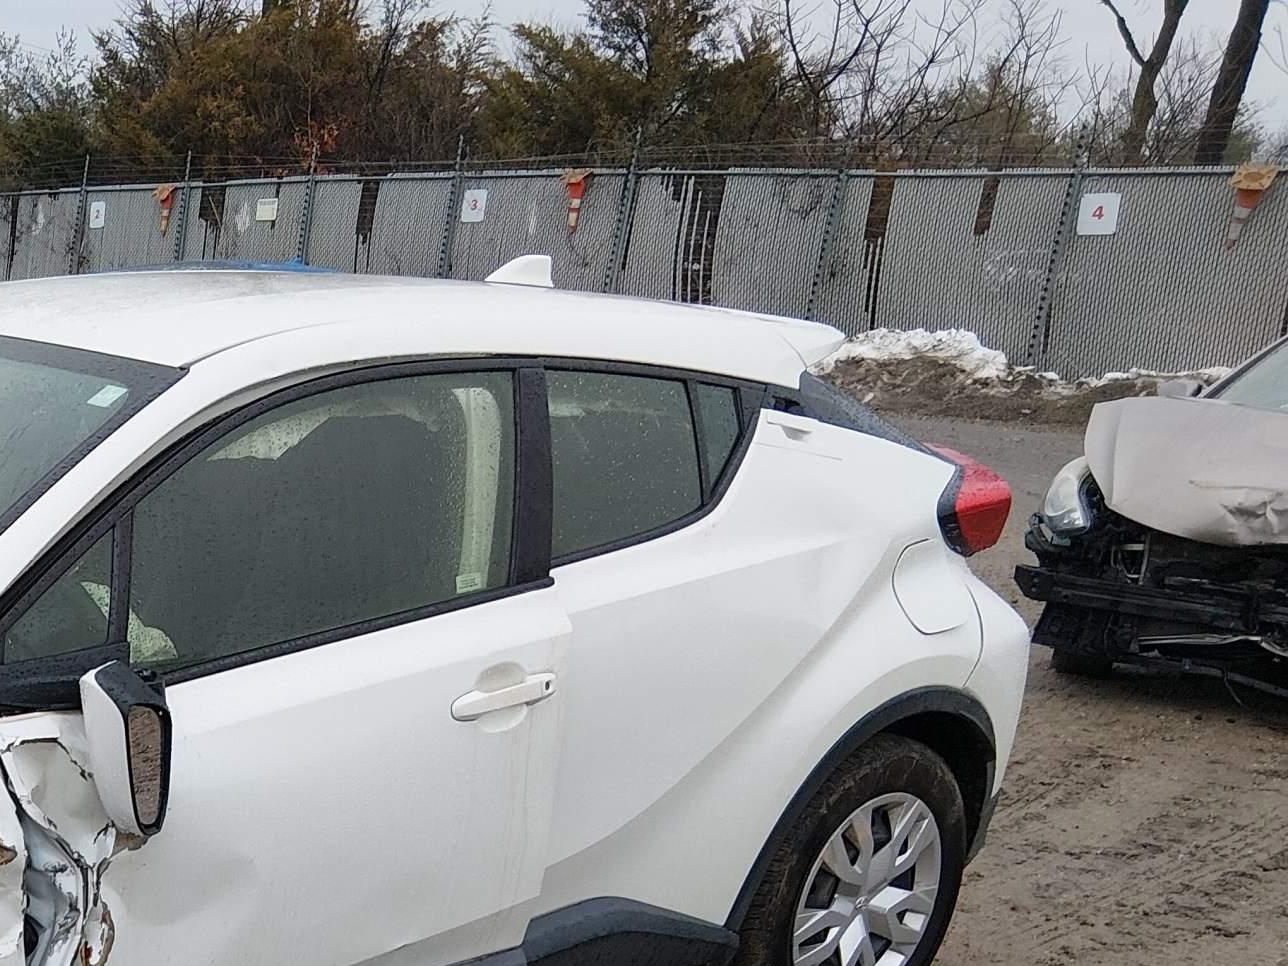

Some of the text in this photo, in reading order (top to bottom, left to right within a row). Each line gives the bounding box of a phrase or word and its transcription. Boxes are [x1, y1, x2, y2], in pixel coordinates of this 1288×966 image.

[471, 199, 478, 211] 3
[95, 209, 101, 219] 2
[1091, 205, 1105, 220] 4
